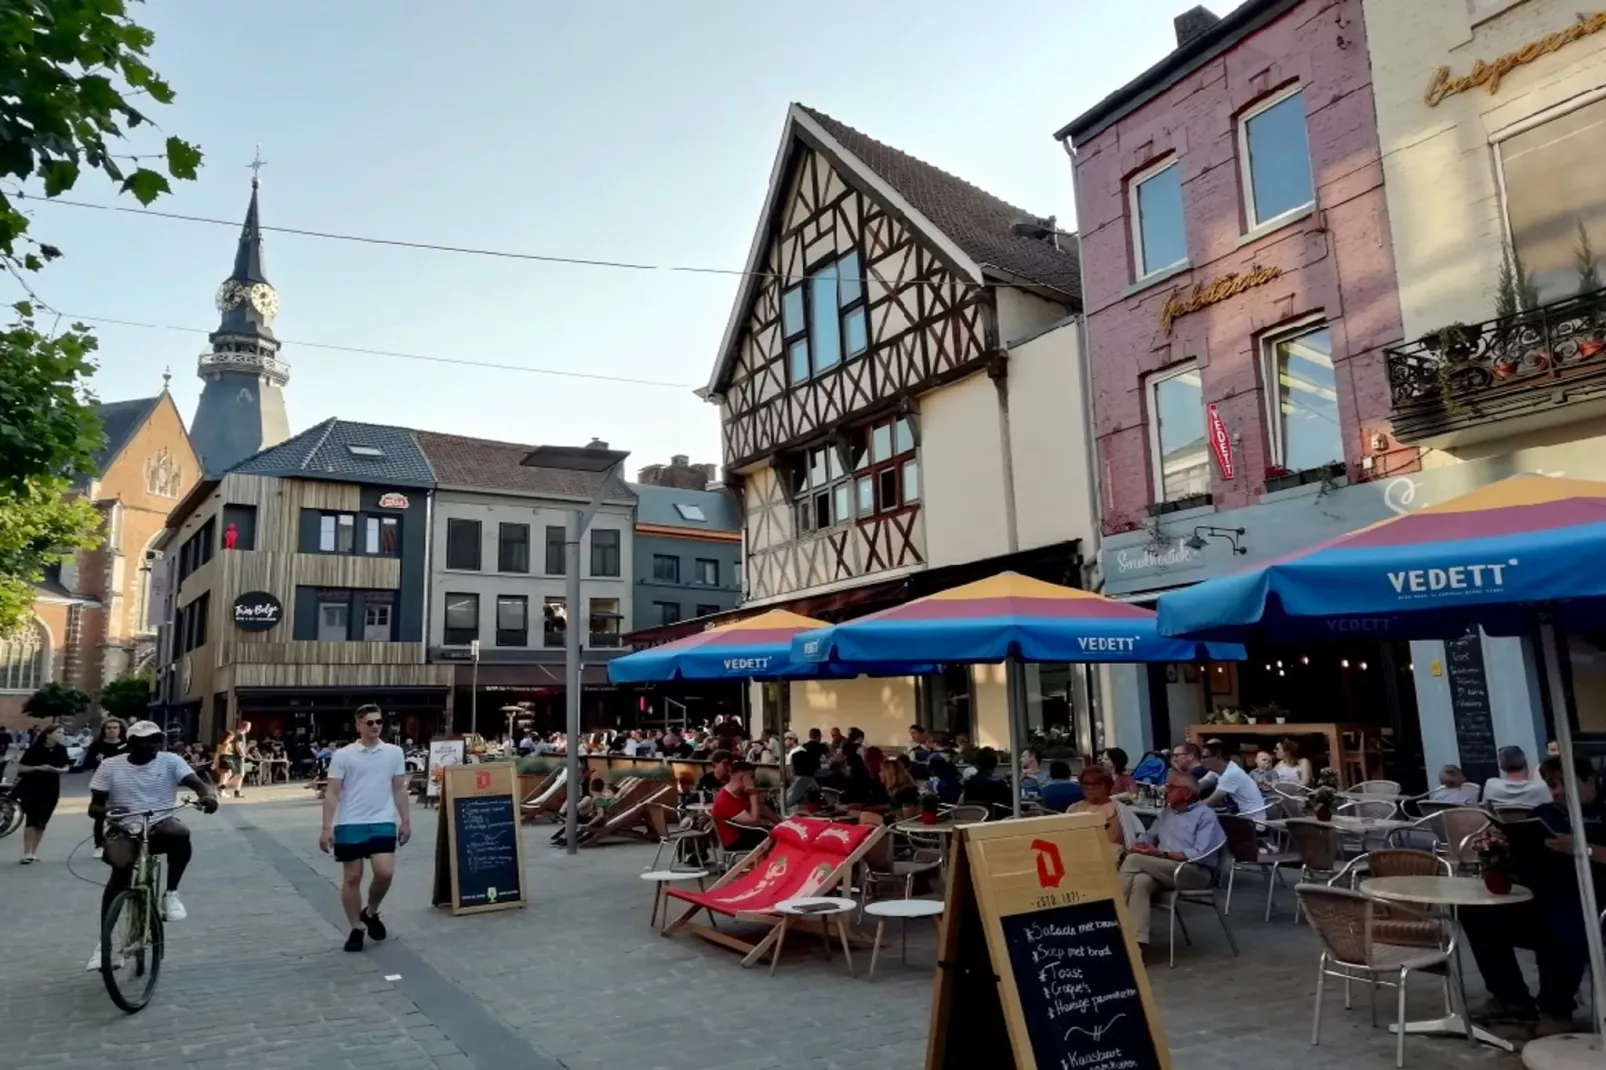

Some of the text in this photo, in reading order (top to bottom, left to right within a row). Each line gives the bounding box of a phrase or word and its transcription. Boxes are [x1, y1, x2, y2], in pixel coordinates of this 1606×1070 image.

[1211, 410, 1232, 475] VEDETT
[1387, 564, 1506, 593] VEDETT
[1077, 637, 1135, 651] VEDETT
[723, 658, 769, 669] VEDETT
[1044, 961, 1083, 980] Toast
